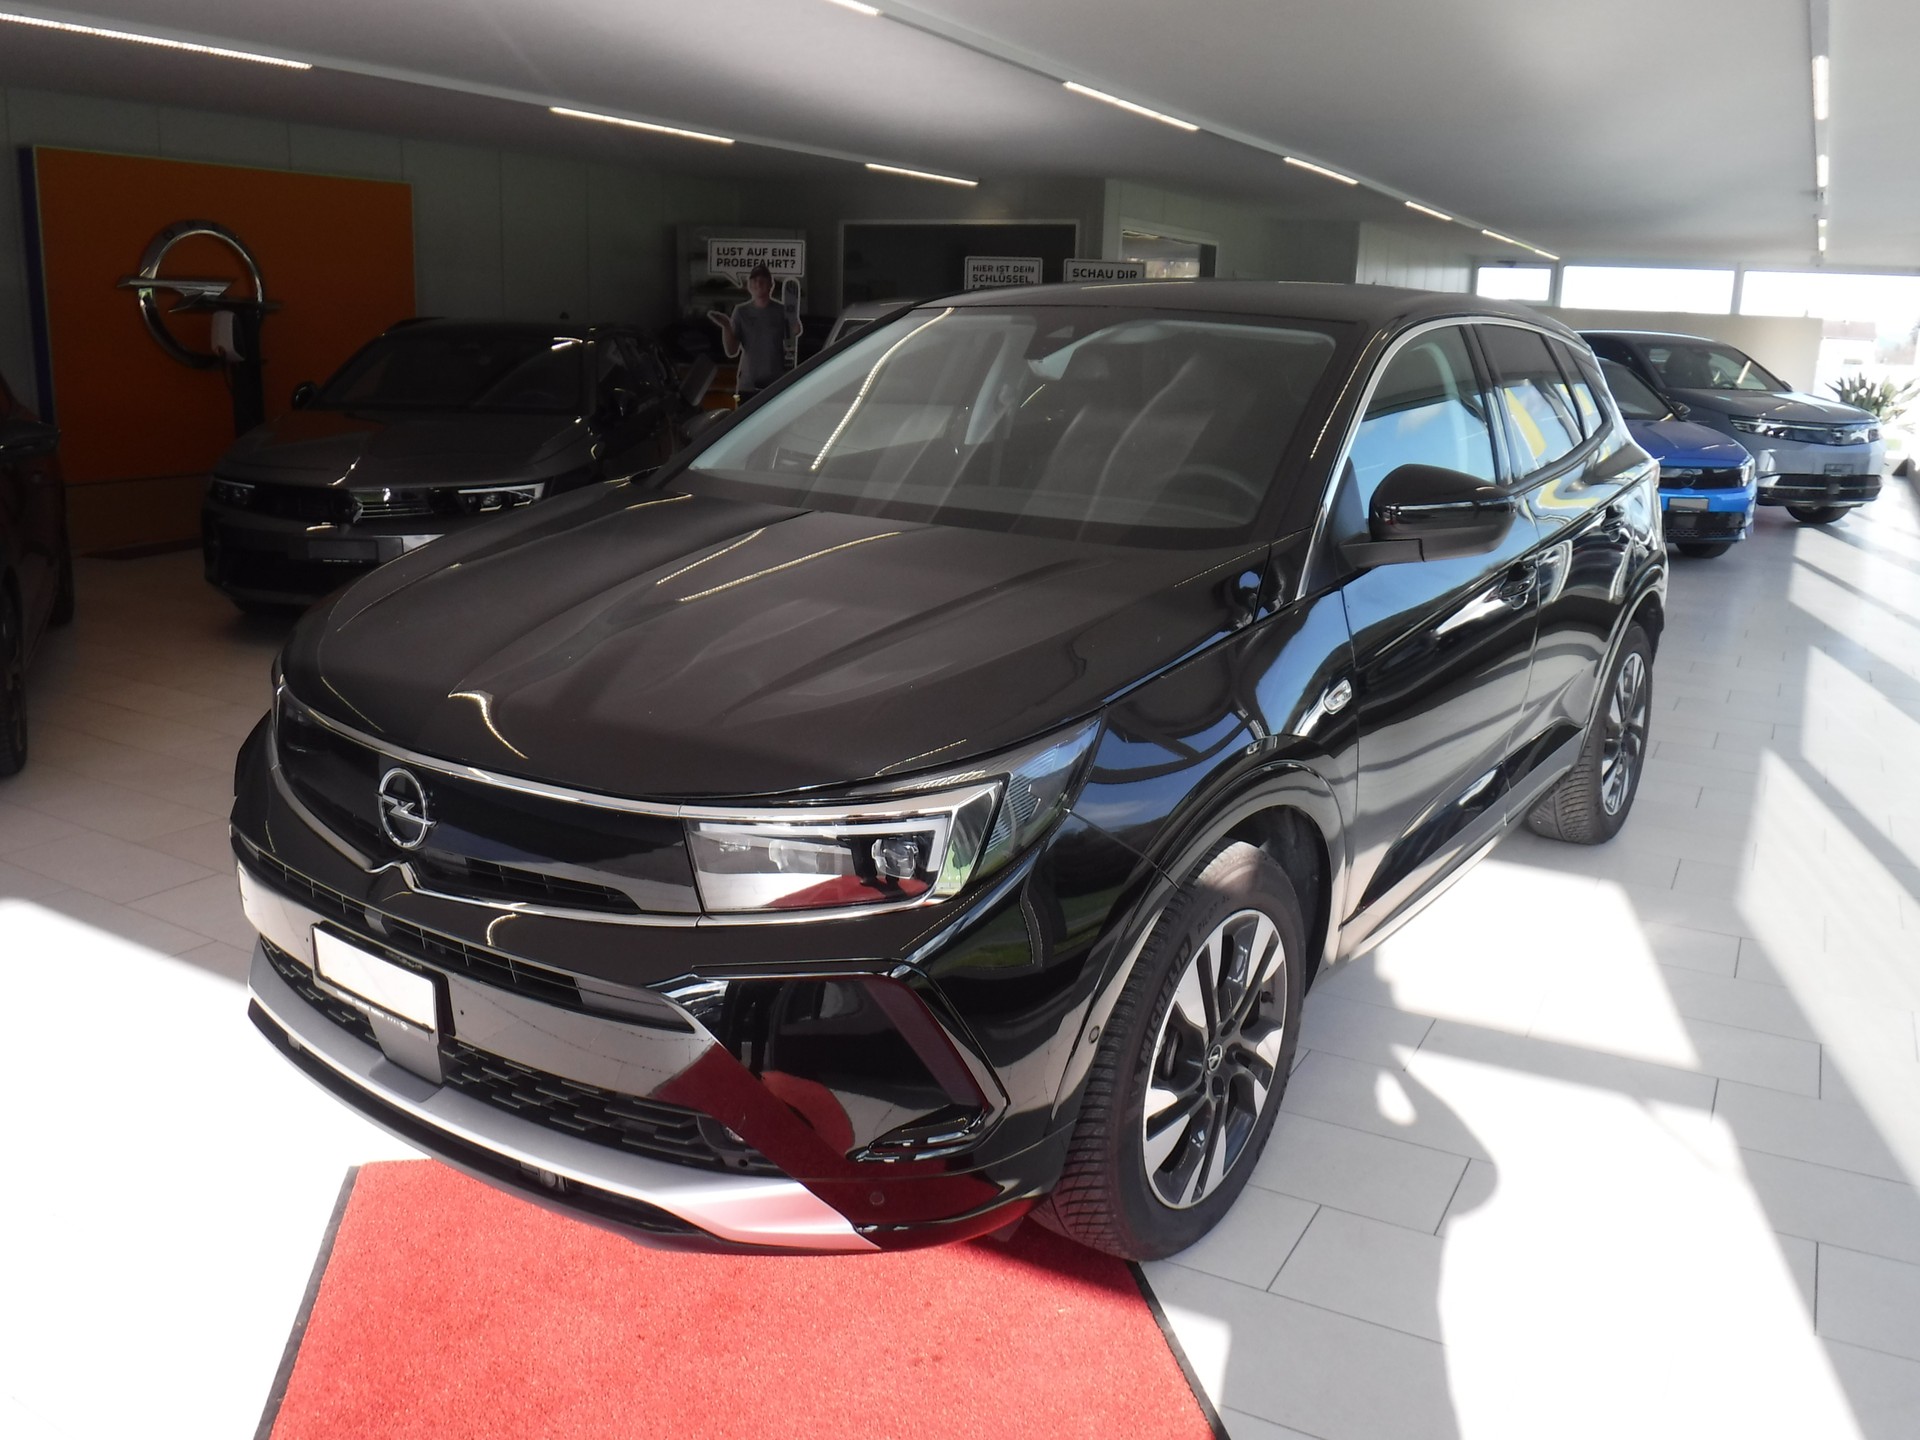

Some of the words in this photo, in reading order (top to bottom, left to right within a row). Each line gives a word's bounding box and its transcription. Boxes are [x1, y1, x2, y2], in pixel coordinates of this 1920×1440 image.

[716, 247, 744, 256] LUST
[746, 247, 769, 256] AUF
[772, 248, 796, 256] EINE
[716, 258, 796, 268] PROBEFAHRT?
[972, 264, 994, 272] HIER
[1013, 265, 1035, 273] DEIN
[1072, 268, 1114, 279] SCHAU
[1117, 269, 1138, 279] DIR
[972, 272, 1034, 284] SCHLÜSSEL,
[1139, 941, 1191, 1062] MICHELIN
